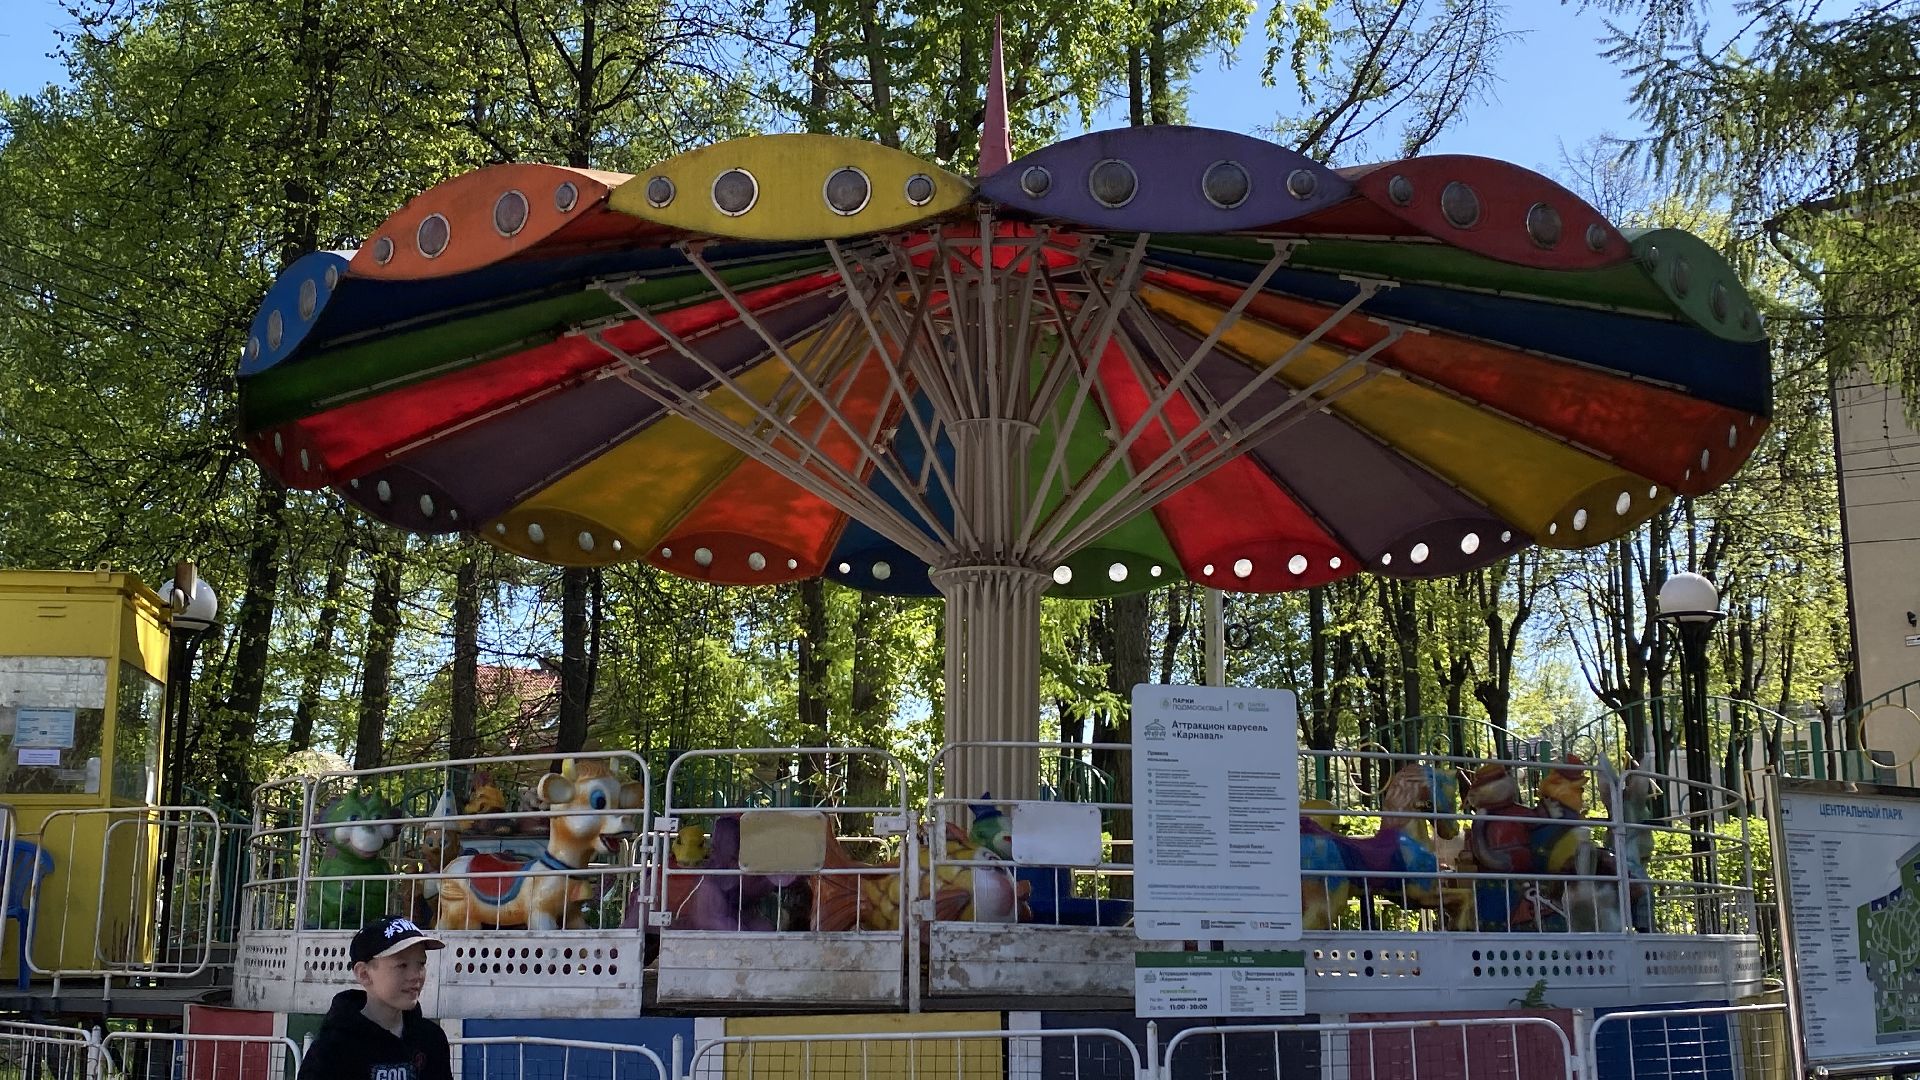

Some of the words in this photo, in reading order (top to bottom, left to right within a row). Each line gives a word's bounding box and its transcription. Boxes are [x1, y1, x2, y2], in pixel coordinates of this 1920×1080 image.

[1171, 720, 1225, 731] Аттракцион
[1227, 723, 1269, 732] карусель
[1172, 730, 1224, 740] «Карнавал»
[1819, 803, 1882, 819] ЦЕНТРАЛЬНЫЙ
[1882, 807, 1904, 820] ПАРК
